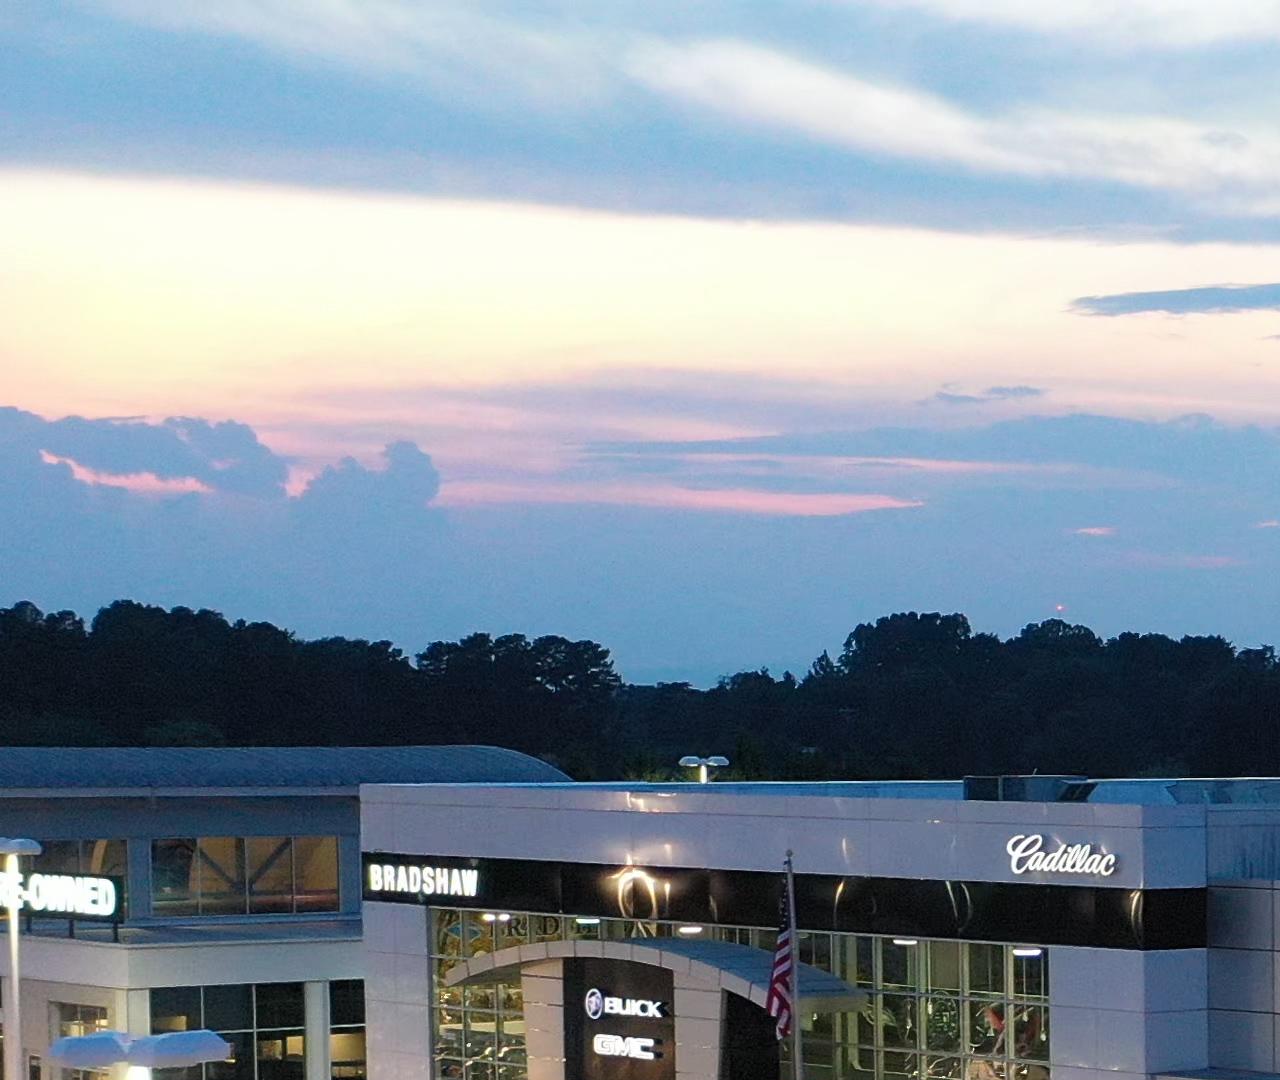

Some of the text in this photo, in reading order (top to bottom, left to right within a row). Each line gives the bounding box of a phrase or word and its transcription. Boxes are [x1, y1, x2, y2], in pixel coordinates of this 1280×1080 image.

[1006, 834, 1116, 876] Cadillac
[369, 864, 478, 897] BRADSHAW
[604, 997, 662, 1018] BUICK
[593, 1033, 656, 1060] GMC
